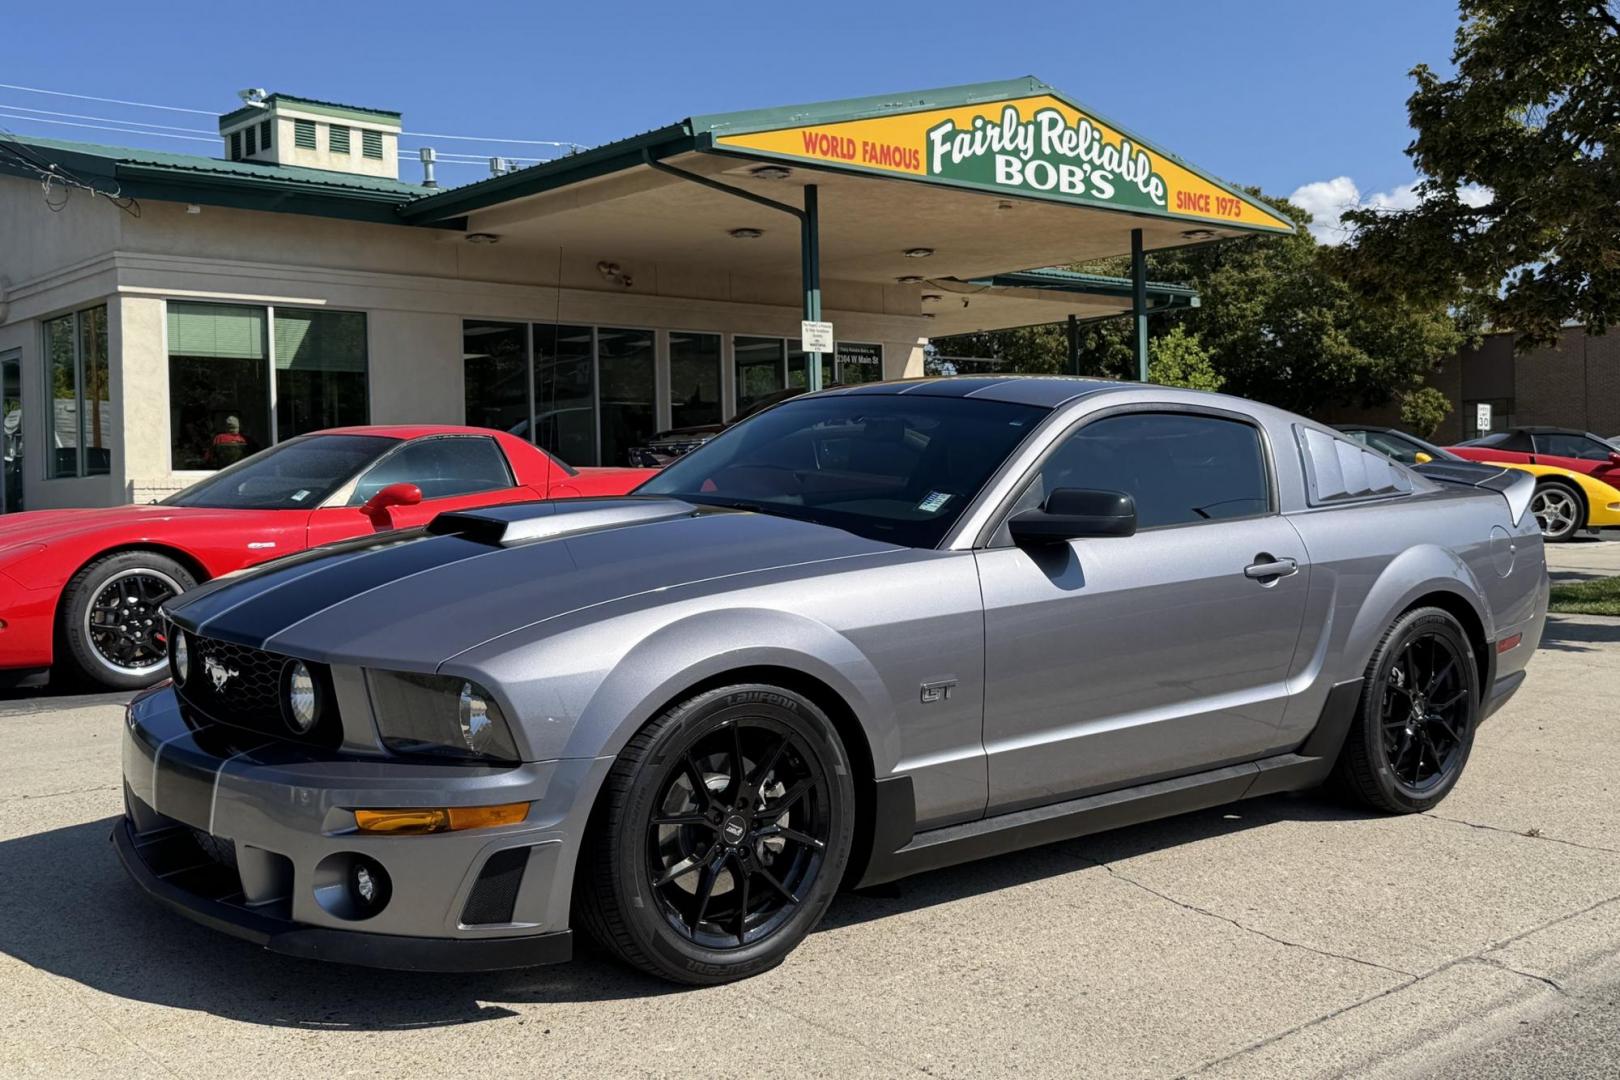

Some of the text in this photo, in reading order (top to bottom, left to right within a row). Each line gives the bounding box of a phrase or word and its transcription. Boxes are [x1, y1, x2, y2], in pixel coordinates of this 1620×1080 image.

[802, 130, 920, 170] WORLD FAMOUS
[930, 108, 1166, 206] Fairly Reliable
[995, 154, 1115, 200] BOB'S
[1176, 190, 1242, 218] SINCE 1975
[1479, 417, 1489, 427] 30
[920, 679, 958, 704] GT
